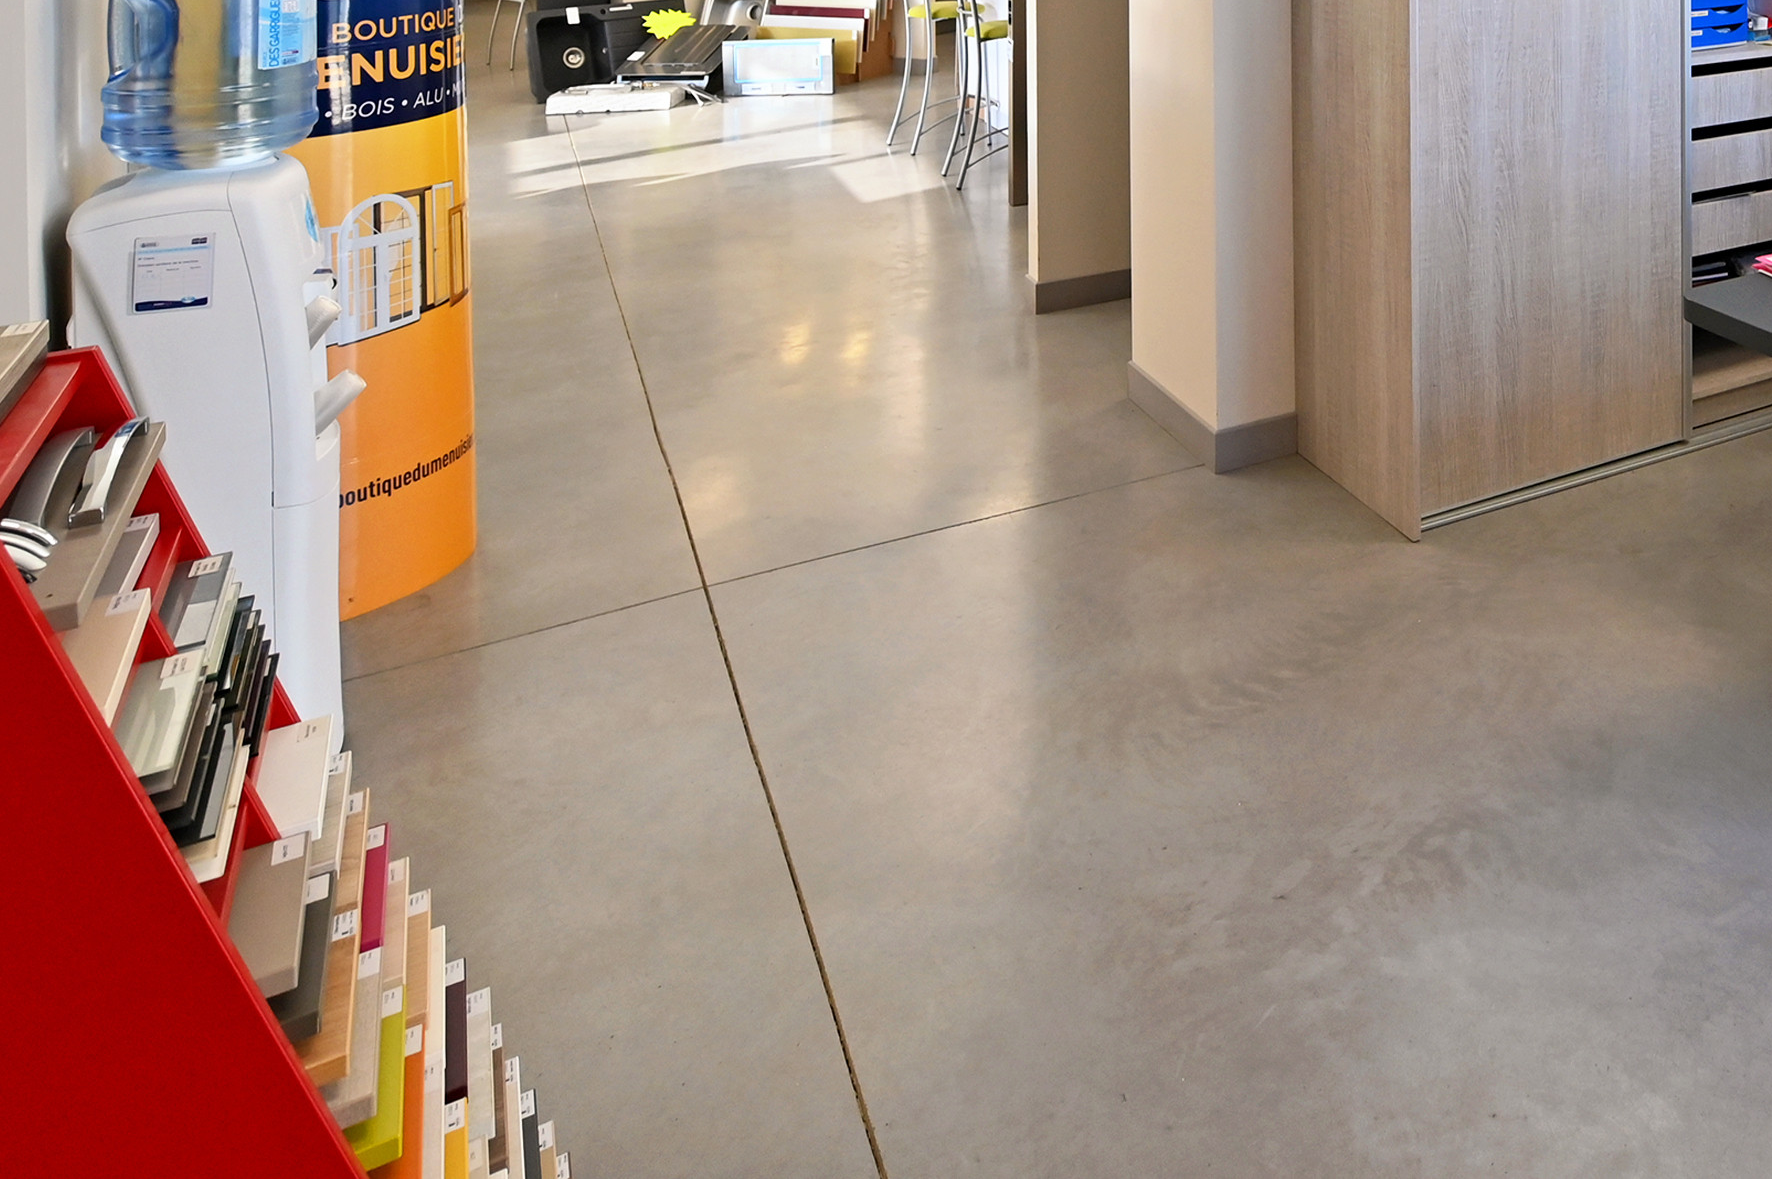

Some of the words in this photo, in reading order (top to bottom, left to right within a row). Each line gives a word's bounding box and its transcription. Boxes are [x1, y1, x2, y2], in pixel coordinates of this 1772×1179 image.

[332, 7, 455, 44] BOUTIQUE
[269, 48, 280, 67] DES
[317, 32, 464, 90] ENUISIE
[341, 97, 396, 121] BOIS
[413, 86, 444, 109] ALU
